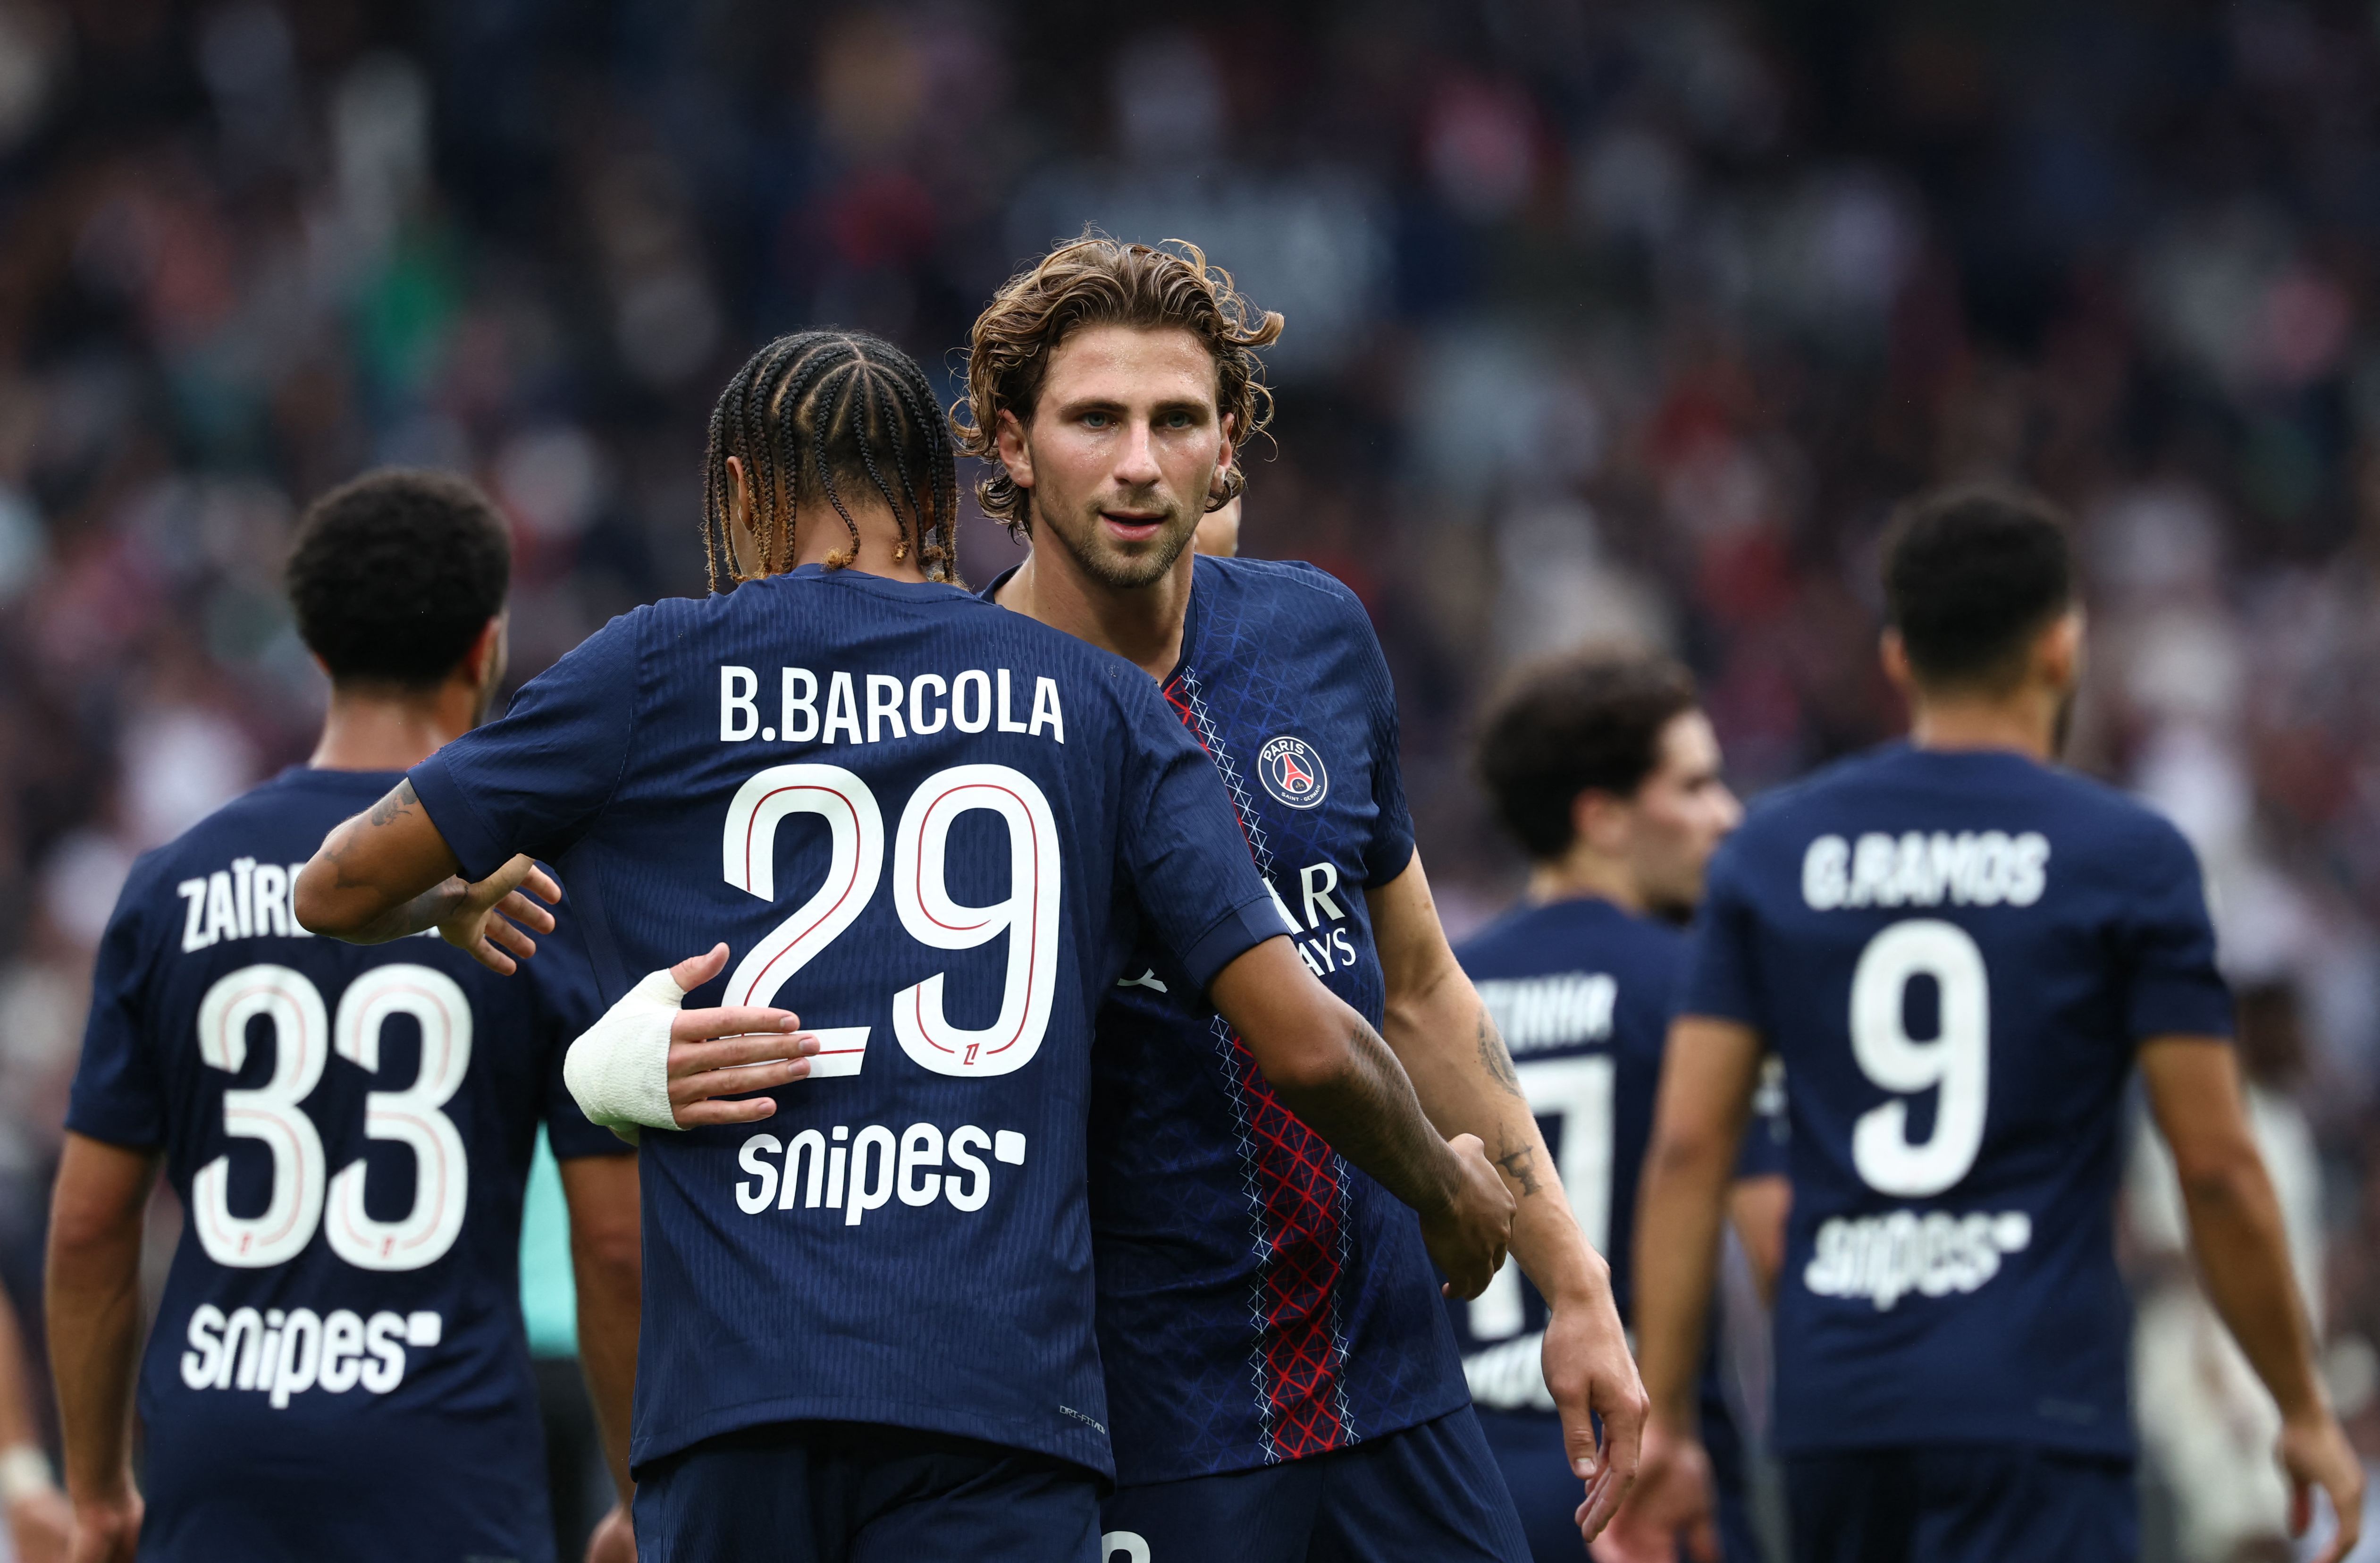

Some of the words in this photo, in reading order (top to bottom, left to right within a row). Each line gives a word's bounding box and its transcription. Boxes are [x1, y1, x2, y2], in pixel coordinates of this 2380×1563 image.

[720, 666, 1064, 744] B.BARCOLA
[1263, 740, 1304, 762] PARIS
[719, 763, 1061, 1077] 29
[1850, 920, 1988, 1195] 9
[193, 963, 472, 1271] 33
[736, 1123, 992, 1226] snipes
[181, 1304, 406, 1409] snipes
